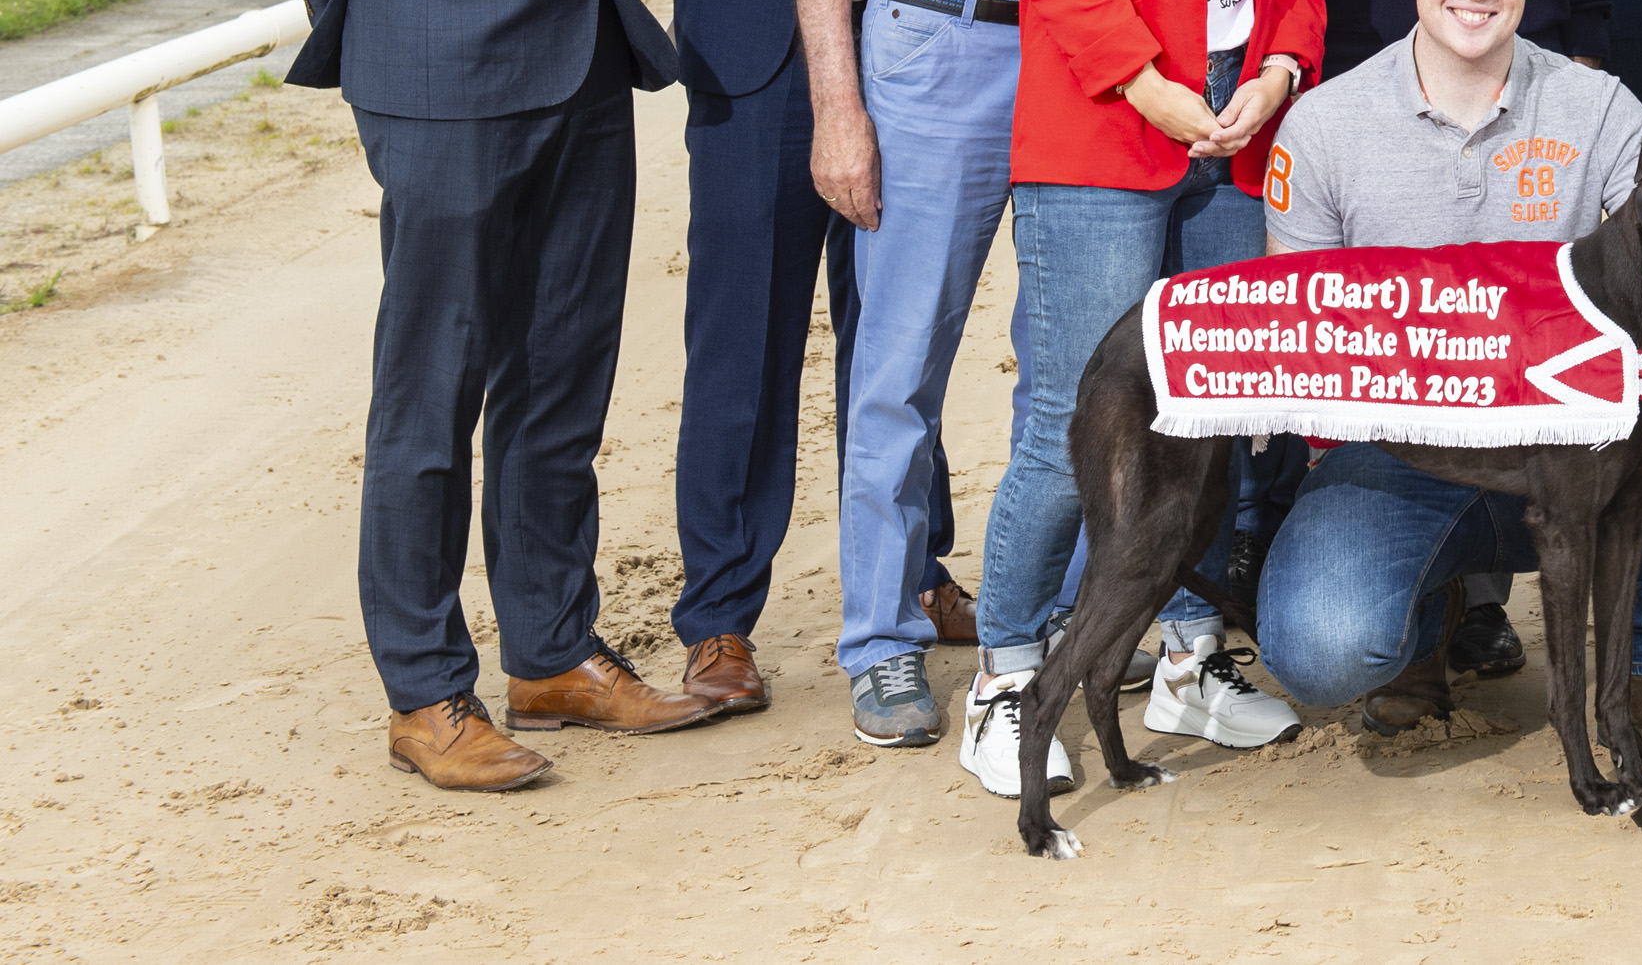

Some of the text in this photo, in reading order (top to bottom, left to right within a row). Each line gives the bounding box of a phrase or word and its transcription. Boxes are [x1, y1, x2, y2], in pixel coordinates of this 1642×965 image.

[1493, 137, 1580, 172] SUPERDRY
[1518, 165, 1555, 197] 68
[1168, 272, 1508, 320] Michael (Bart) Leahy
[1163, 319, 1511, 360] Memorial Stake Winner
[1185, 363, 1497, 407] Curraheen Park 2023
